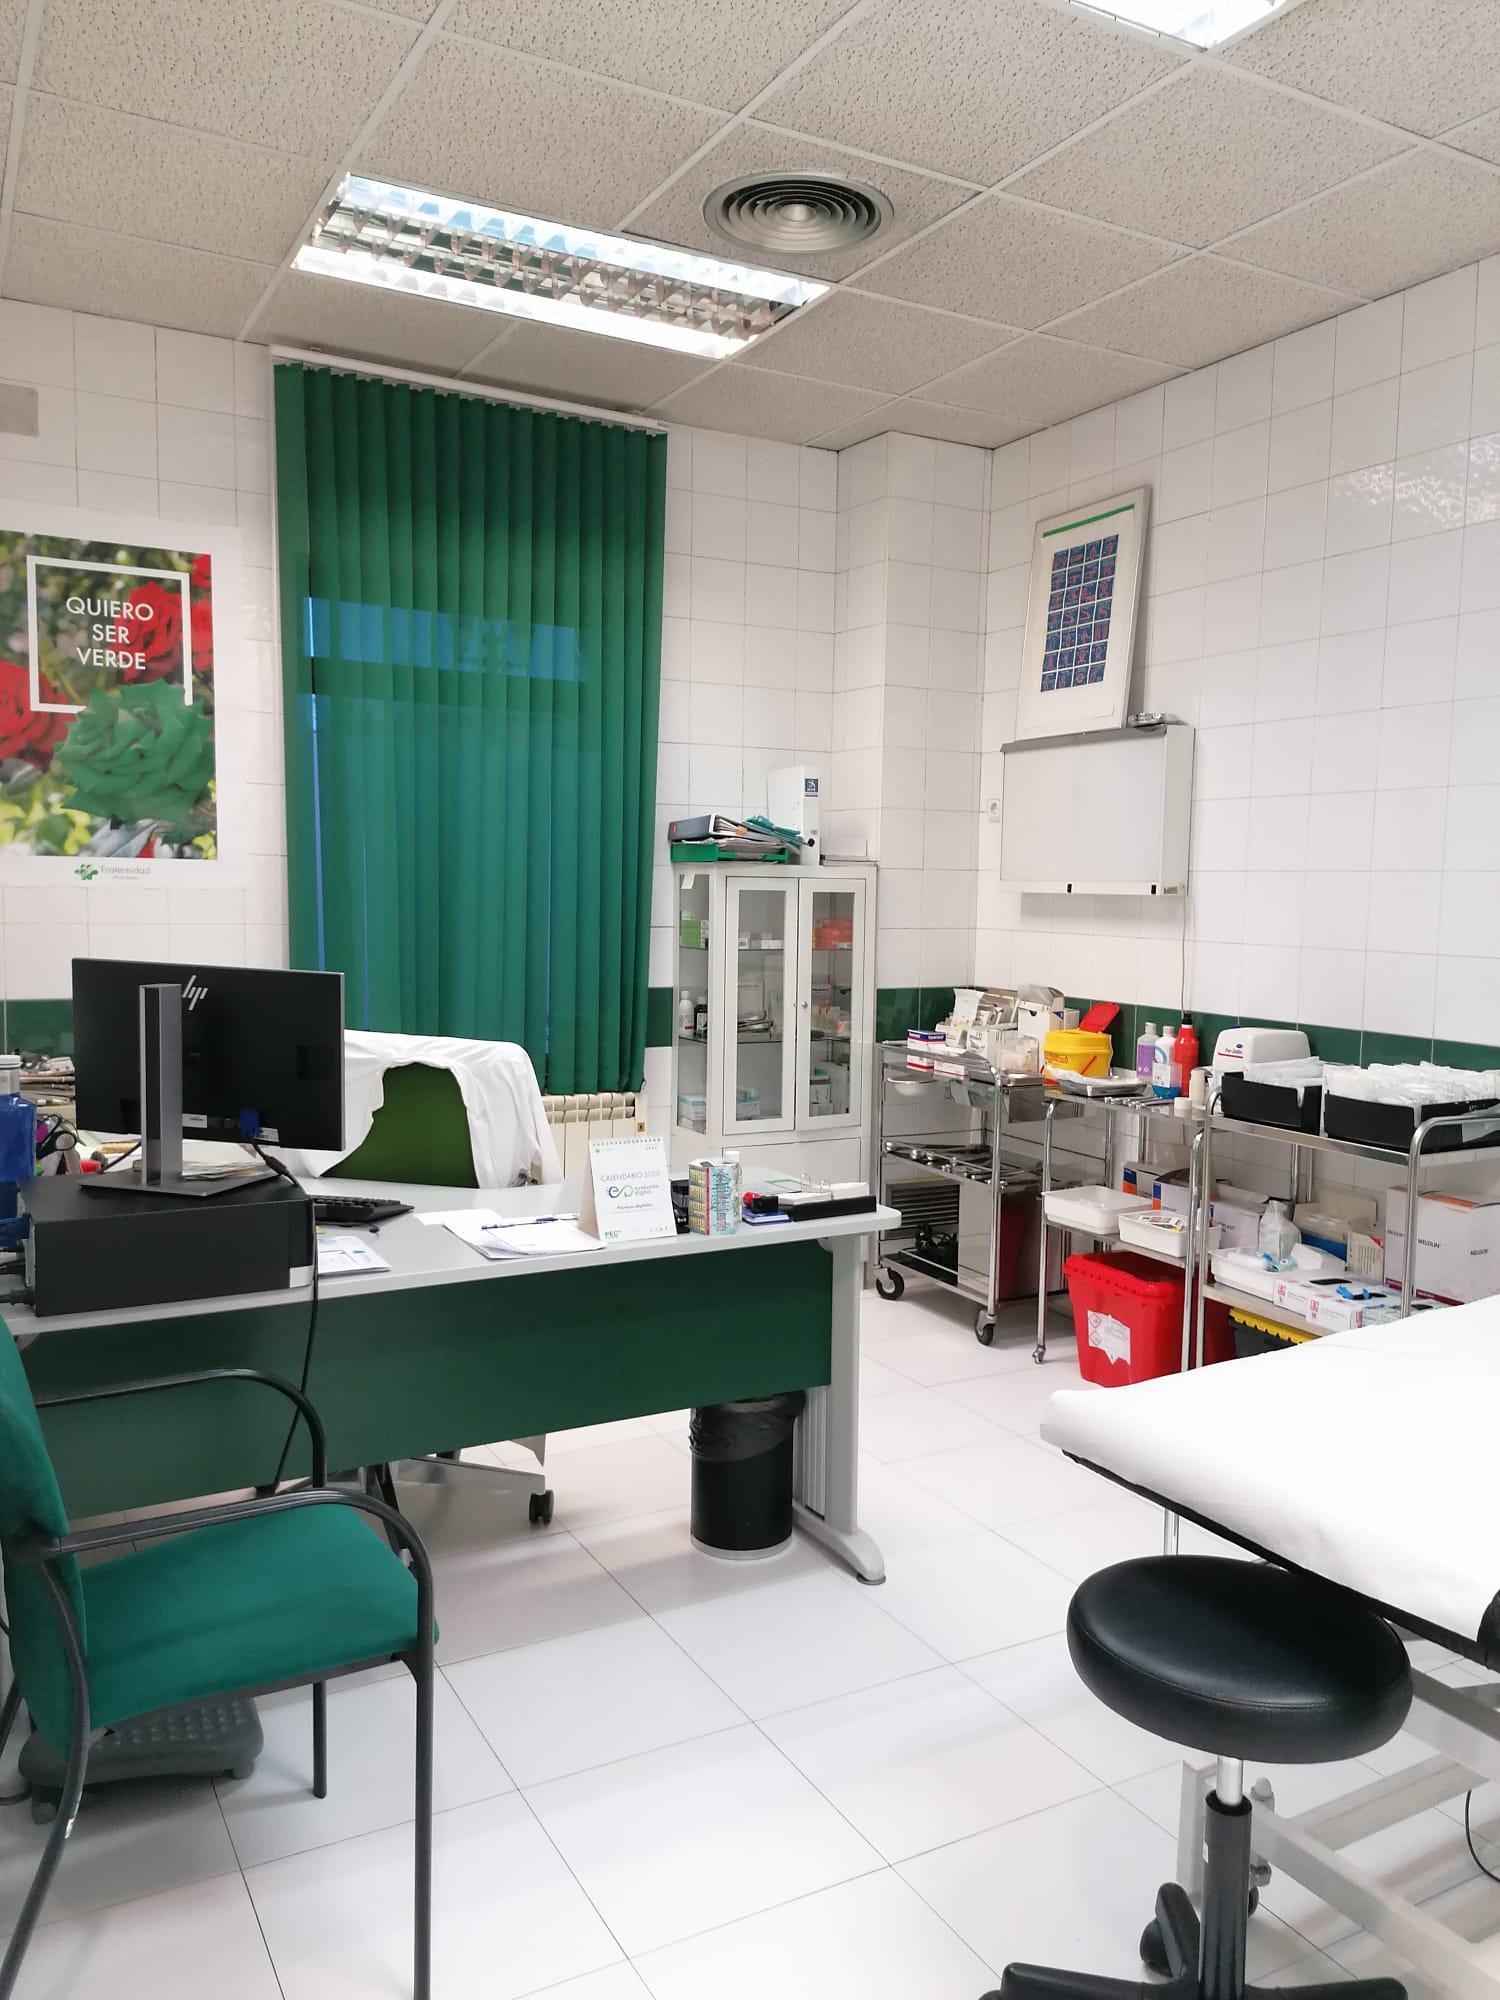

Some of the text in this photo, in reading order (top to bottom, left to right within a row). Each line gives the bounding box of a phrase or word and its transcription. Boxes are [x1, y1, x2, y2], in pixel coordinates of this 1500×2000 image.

[66, 597, 154, 621] QUIERO
[92, 624, 130, 644] SER
[76, 647, 146, 670] VERDE
[1417, 1238, 1441, 1249] MELOLIN
